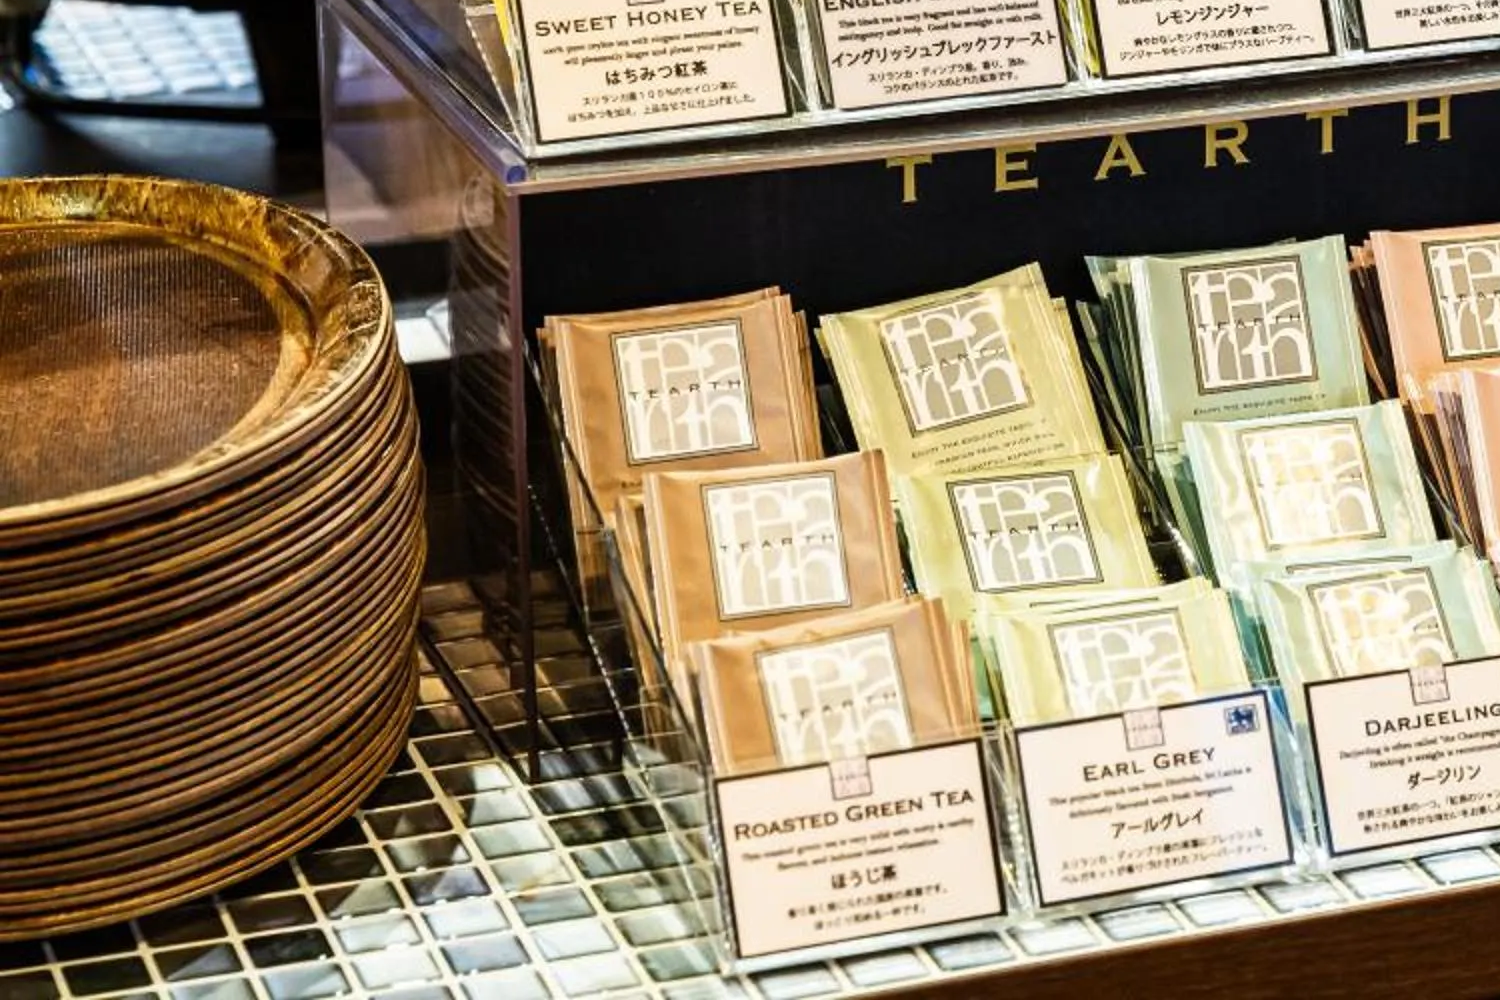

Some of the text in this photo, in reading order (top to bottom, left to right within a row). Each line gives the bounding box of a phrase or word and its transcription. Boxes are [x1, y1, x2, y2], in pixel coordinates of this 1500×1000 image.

[533, 13, 618, 37] SWEET
[626, 4, 709, 27] HONEY
[1155, 0, 1270, 26] レモンジンジャー
[604, 59, 708, 86] はちみつ紅茶
[886, 96, 1452, 203] TEARTH
[1082, 744, 1217, 782] EARL GREY
[1406, 761, 1482, 791] ダージリン
[733, 808, 839, 841] ROASTED
[843, 794, 924, 823] GREEN
[928, 785, 974, 809] TEA
[1110, 807, 1205, 839] アールグレイ
[830, 863, 897, 890] ほうじ茶
